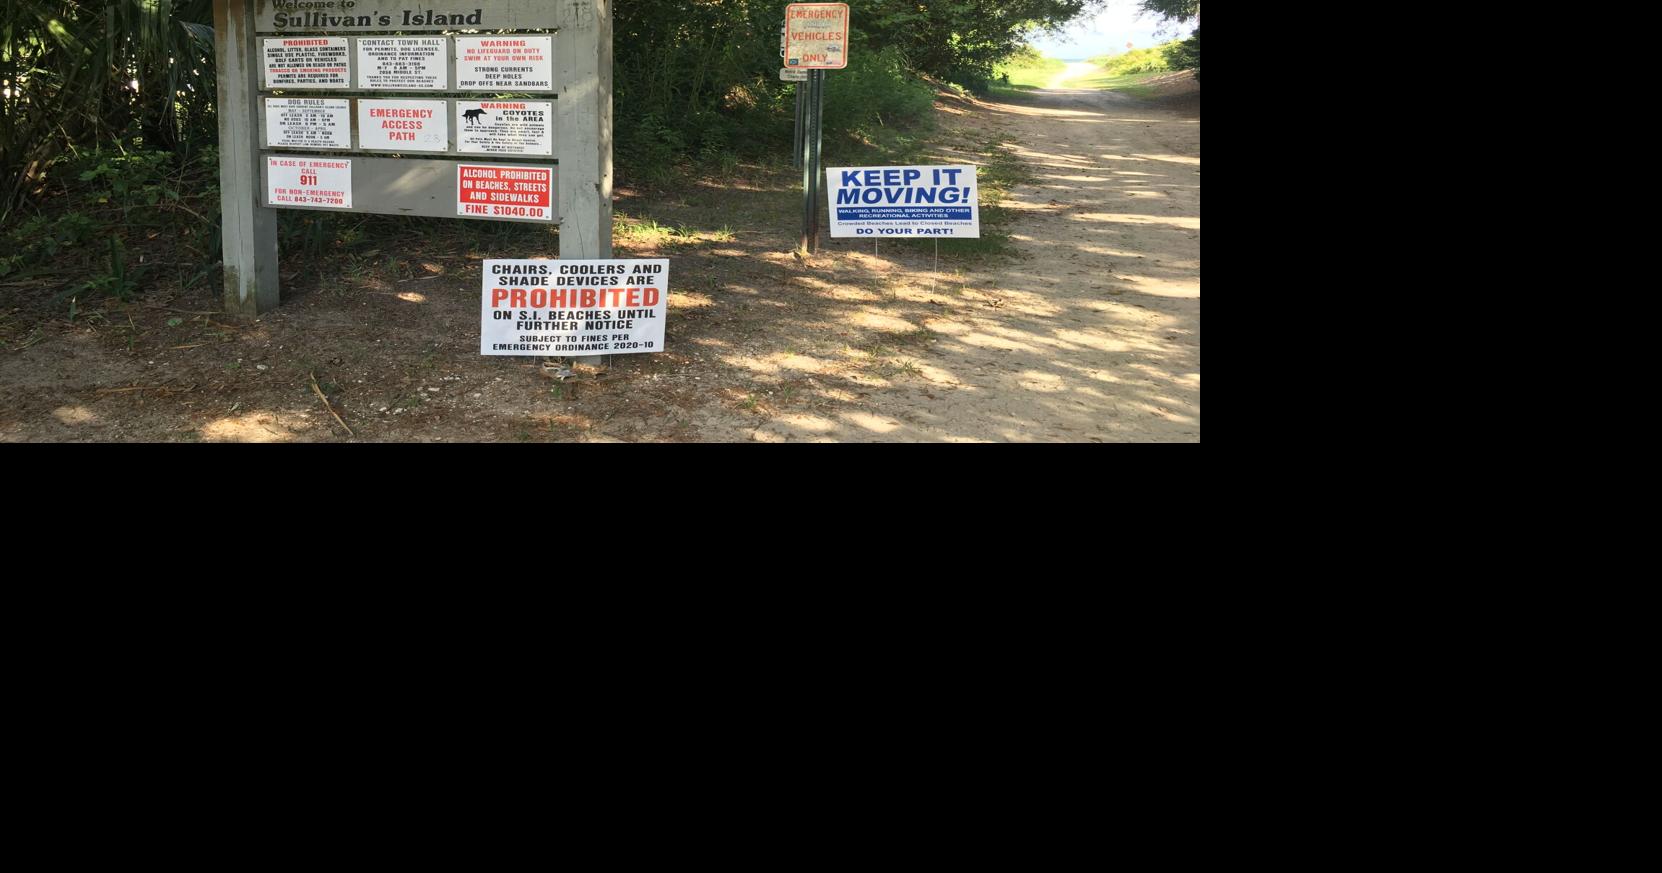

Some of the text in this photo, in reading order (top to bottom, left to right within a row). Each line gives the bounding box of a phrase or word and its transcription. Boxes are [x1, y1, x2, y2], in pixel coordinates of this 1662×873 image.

[272, 0, 335, 8] Welcome
[273, 9, 482, 28] Sullivan's Island
[791, 10, 843, 19] EMERGENCY
[792, 32, 842, 40] VEHICLES
[370, 109, 432, 118] EMERGENCY
[382, 120, 423, 129] ACCESS
[389, 132, 415, 141] PATH
[464, 169, 546, 180] ALCOHOL PROHIBITED
[841, 169, 962, 186] KEEP IT
[300, 175, 317, 185] 911
[463, 180, 546, 192] ON BEACHES, STREETS
[289, 189, 344, 197] NON-EMERGENCY
[470, 191, 539, 203] AND SIDEWALKS
[836, 187, 970, 204] MOVING!
[466, 205, 488, 214] FINE
[492, 264, 662, 275] CHAIRS, COOLERS AND
[499, 276, 654, 286] SHADE DEVICES ARE
[492, 288, 659, 308] PROHIBITED
[493, 309, 656, 320] ON S.I. BEACHES UNTIL
[517, 320, 633, 331] FURTHER NOTICE
